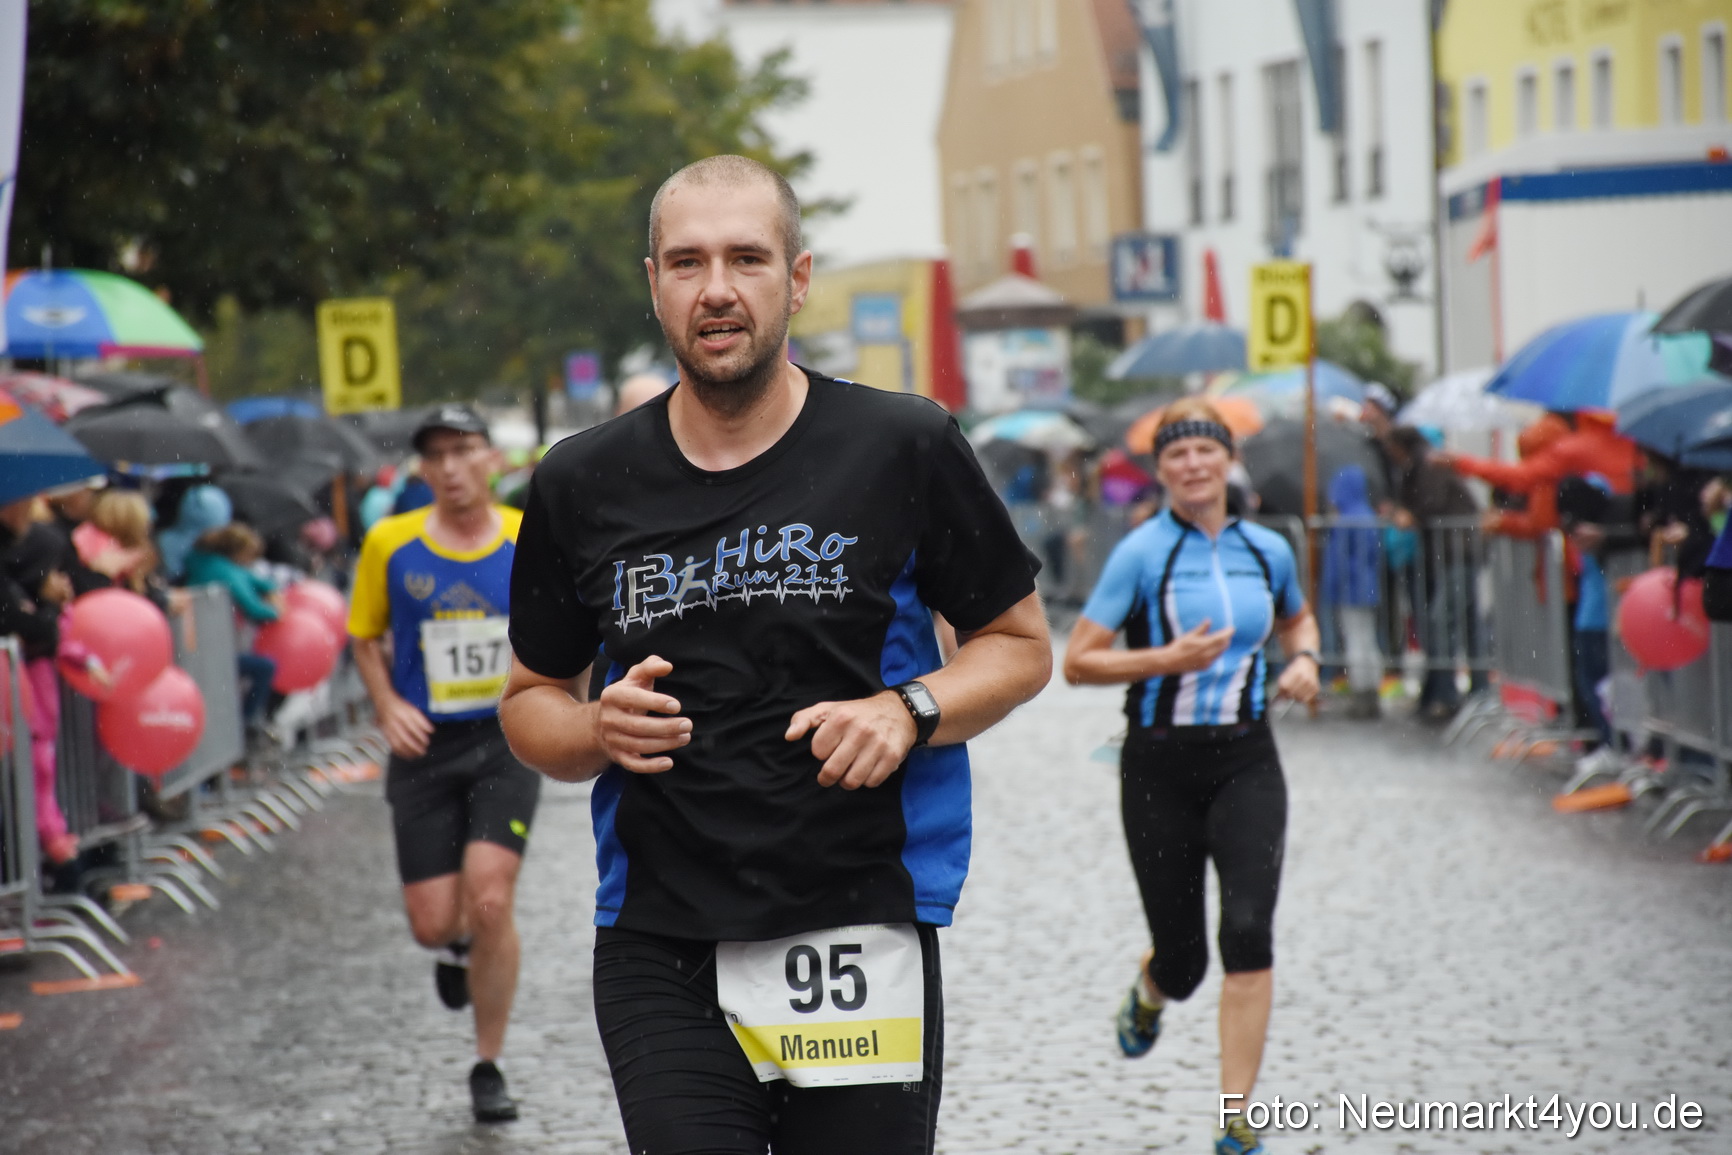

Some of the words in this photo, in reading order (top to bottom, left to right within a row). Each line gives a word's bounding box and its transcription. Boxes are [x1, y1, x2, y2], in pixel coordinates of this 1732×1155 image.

[1265, 295, 1298, 346] D
[342, 335, 379, 387] D
[714, 522, 859, 571] HiRo
[711, 569, 779, 593] Run
[783, 563, 850, 586] 21.1
[446, 638, 503, 676] 157
[784, 943, 869, 1014] 95
[780, 1030, 880, 1062] Manuel
